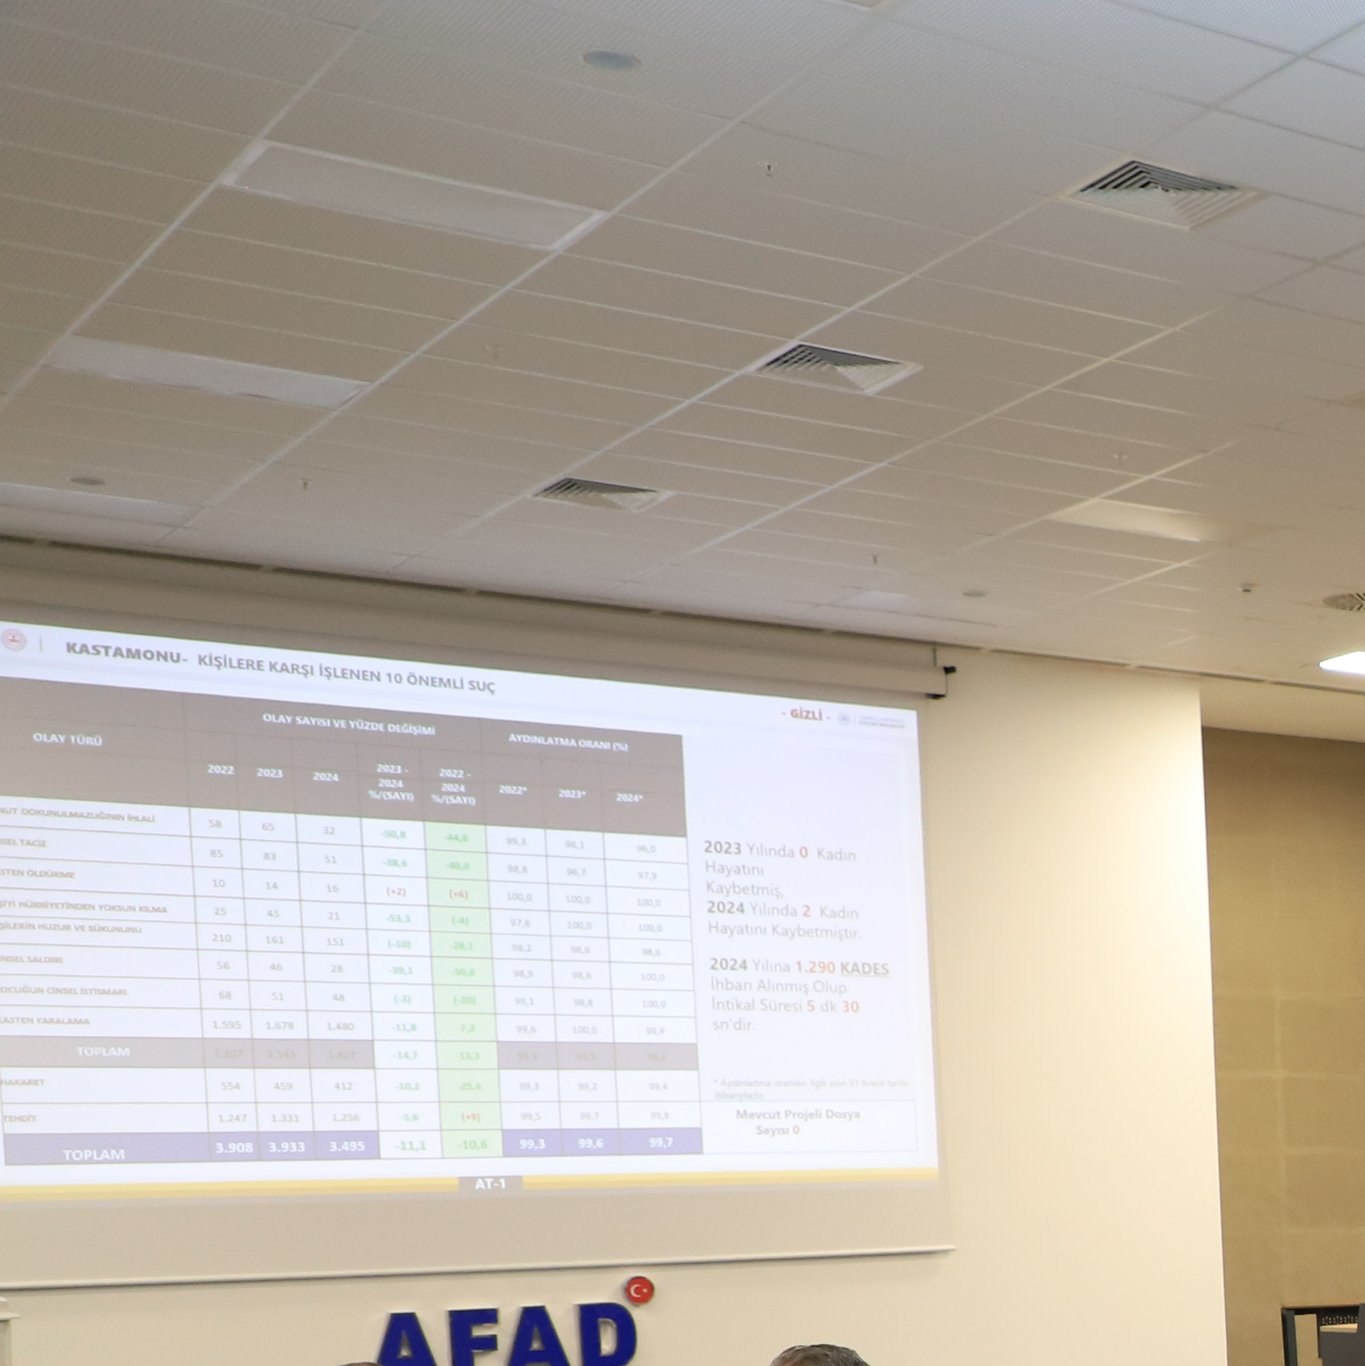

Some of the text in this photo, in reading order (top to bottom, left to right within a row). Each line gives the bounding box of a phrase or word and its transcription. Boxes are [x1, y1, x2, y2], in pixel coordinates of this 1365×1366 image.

[66, 641, 496, 695] KASTAMONU- KİŞİLERE KARŞI İŞLENEN 10 ÖNEMLİ SUÇ
[789, 707, 823, 721] GİZLİ
[262, 712, 292, 725] OLAY
[295, 715, 331, 727] SAYISI
[332, 718, 347, 729] VE
[349, 719, 384, 732] YÜZDE
[32, 732, 102, 746] OLAY TÜRÜ
[207, 763, 235, 775] 2022
[256, 767, 284, 779] 2023
[312, 771, 340, 782] 2024
[703, 839, 857, 862] 2023 Yılında 0 Kadın
[705, 860, 765, 877] Hayatını
[706, 900, 859, 920] 2024 Yılında 2 Kadın
[707, 921, 863, 942] Hayatını Kaybetmiştir.
[212, 933, 232, 943] 210
[709, 957, 890, 975] 2024 Yılına 1.290 KADES
[0, 984, 45, 994] OCUĞUN
[756, 979, 809, 996] Alınmış
[812, 980, 848, 997] Olup
[712, 996, 860, 1013] İntikal Süresi 5 dk 30
[76, 1047, 130, 1057] TOPLAM
[736, 1109, 861, 1122] Mevcut Projeli Dosya
[756, 1125, 800, 1137] Sayısı 0
[215, 1142, 253, 1154] 3.908
[269, 1142, 305, 1153] 3.933
[329, 1141, 365, 1152] 3.495
[395, 1141, 426, 1152] -11,1
[519, 1138, 546, 1150] 99,3
[63, 1150, 125, 1161] TOPLAM
[475, 1179, 506, 1190] AT-1
